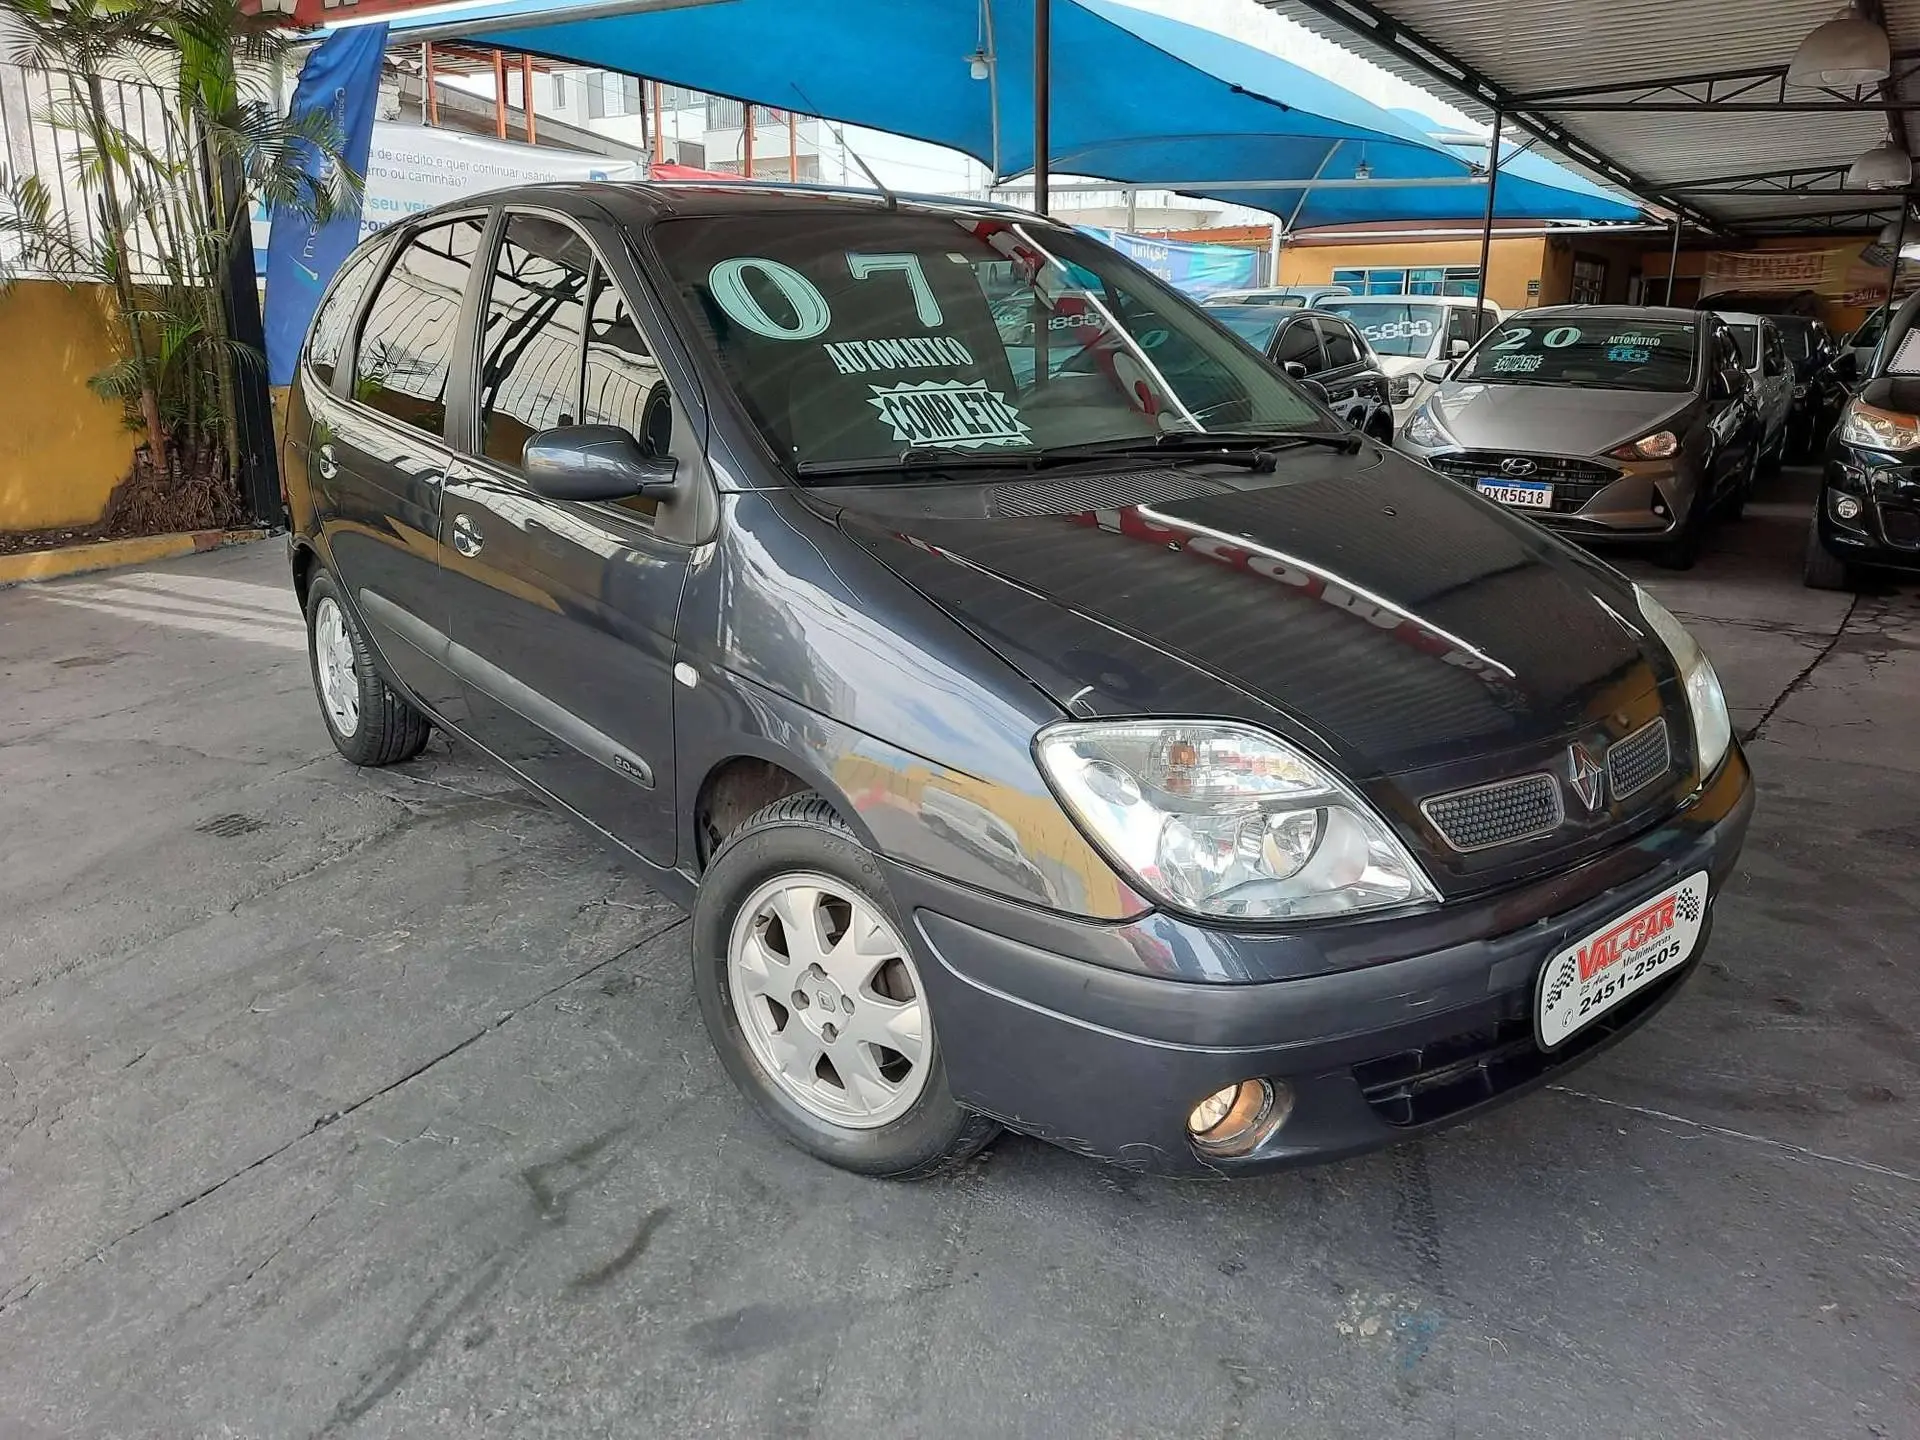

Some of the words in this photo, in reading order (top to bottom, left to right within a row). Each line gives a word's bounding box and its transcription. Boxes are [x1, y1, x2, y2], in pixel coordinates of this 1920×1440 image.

[365, 167, 387, 178] arro
[391, 169, 405, 180] ou
[409, 169, 467, 187] caminhão?
[378, 148, 394, 160] de
[396, 150, 433, 166] crédito
[436, 158, 443, 167] e
[446, 160, 469, 171] quer
[473, 163, 519, 178] continuar
[371, 197, 399, 211] seu
[822, 336, 974, 375] AUTOMATICO
[1607, 335, 1661, 347] AUTOMATICO
[1499, 356, 1540, 372] COMPLETO
[881, 391, 1018, 441] COMPLETO
[1577, 894, 1677, 984] VAL-CAR
[1622, 935, 1671, 968] Multimarcas
[1579, 940, 1681, 1017] 2451-2505
